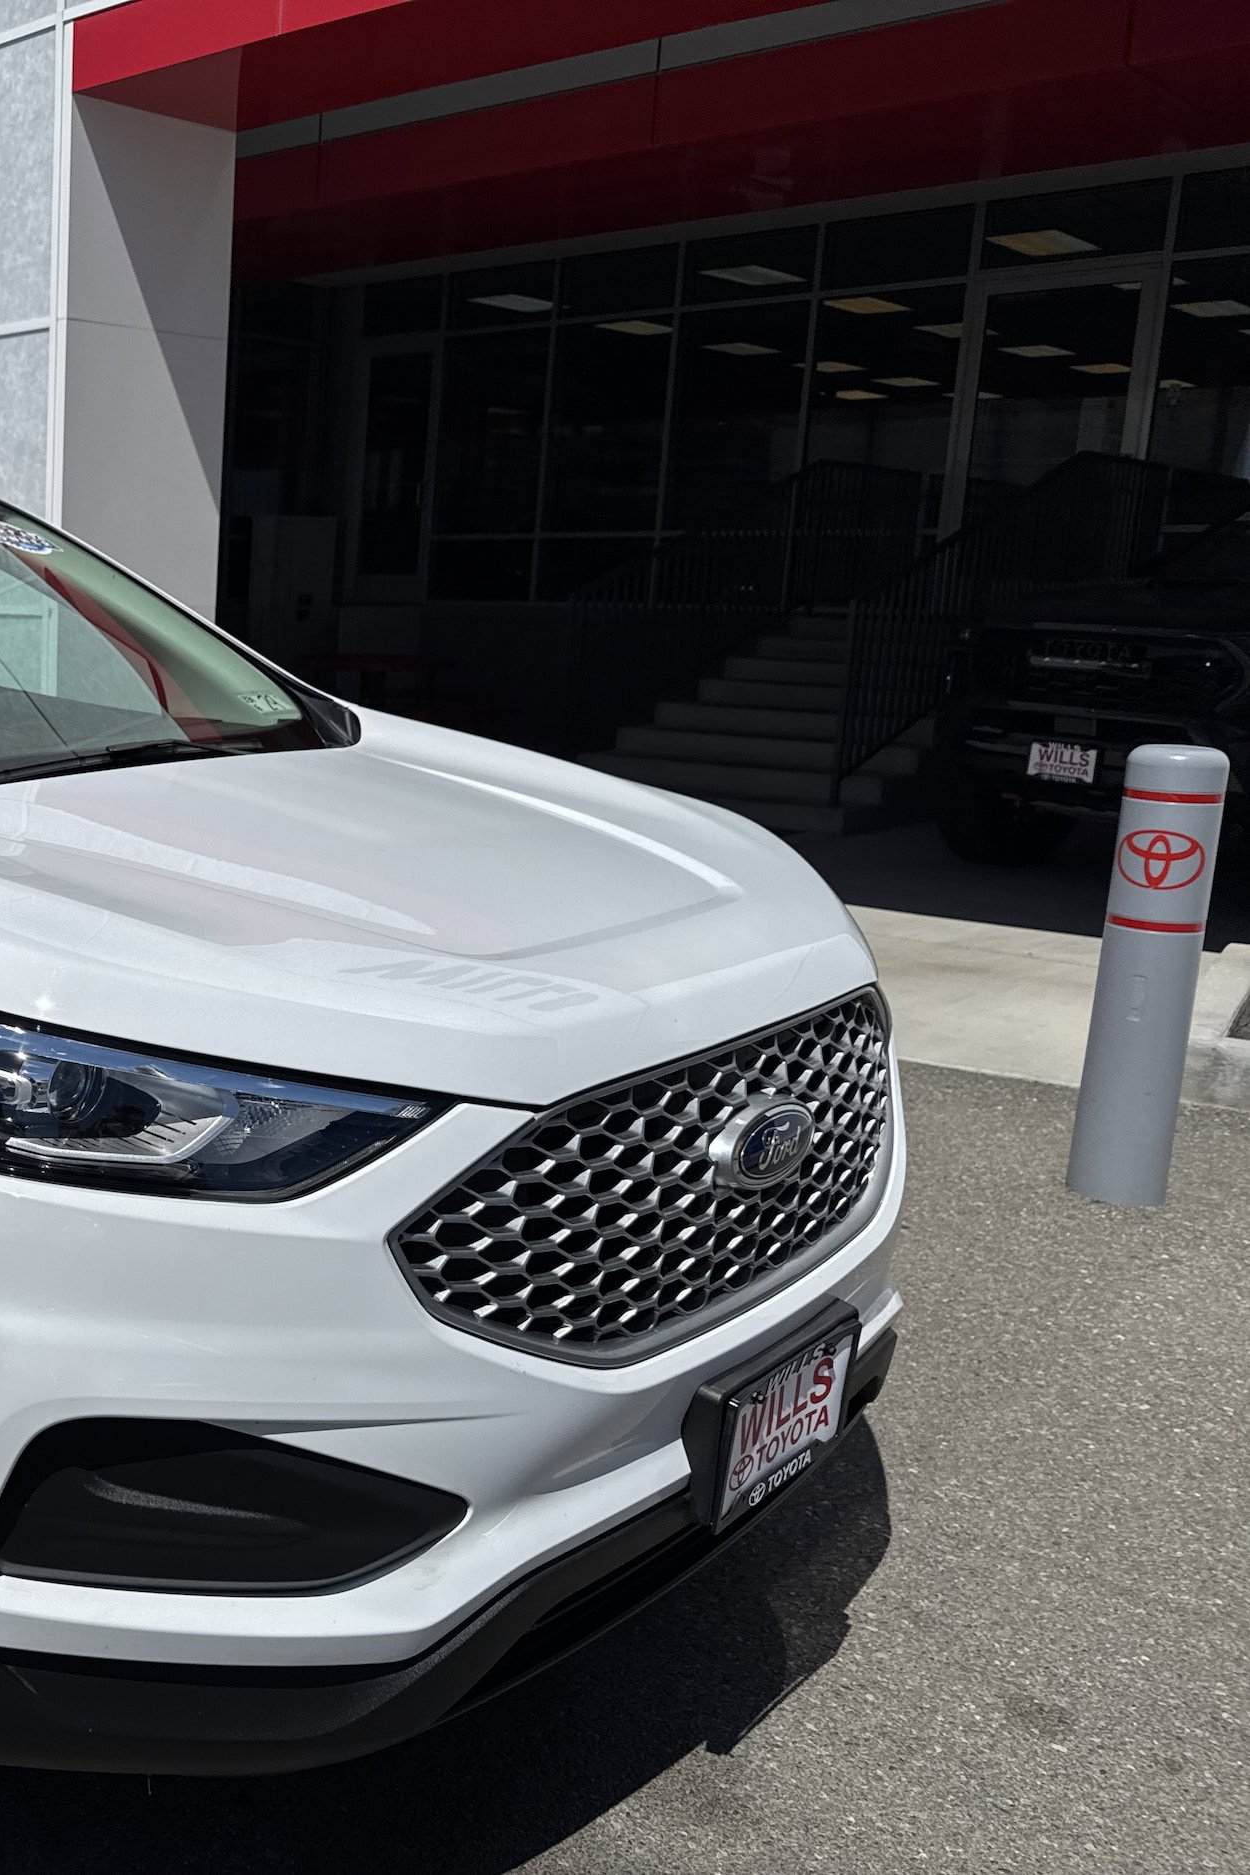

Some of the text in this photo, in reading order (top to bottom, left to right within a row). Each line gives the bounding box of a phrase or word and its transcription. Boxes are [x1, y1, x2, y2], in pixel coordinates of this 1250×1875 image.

[1038, 747, 1090, 767] WILLS
[1049, 764, 1089, 777] TOYOTA
[758, 1121, 802, 1171] Ford
[765, 1342, 828, 1397] WILLS
[740, 1356, 834, 1456] WILLS
[756, 1404, 830, 1471] TOYOTA
[767, 1448, 812, 1494] TOYOTA
